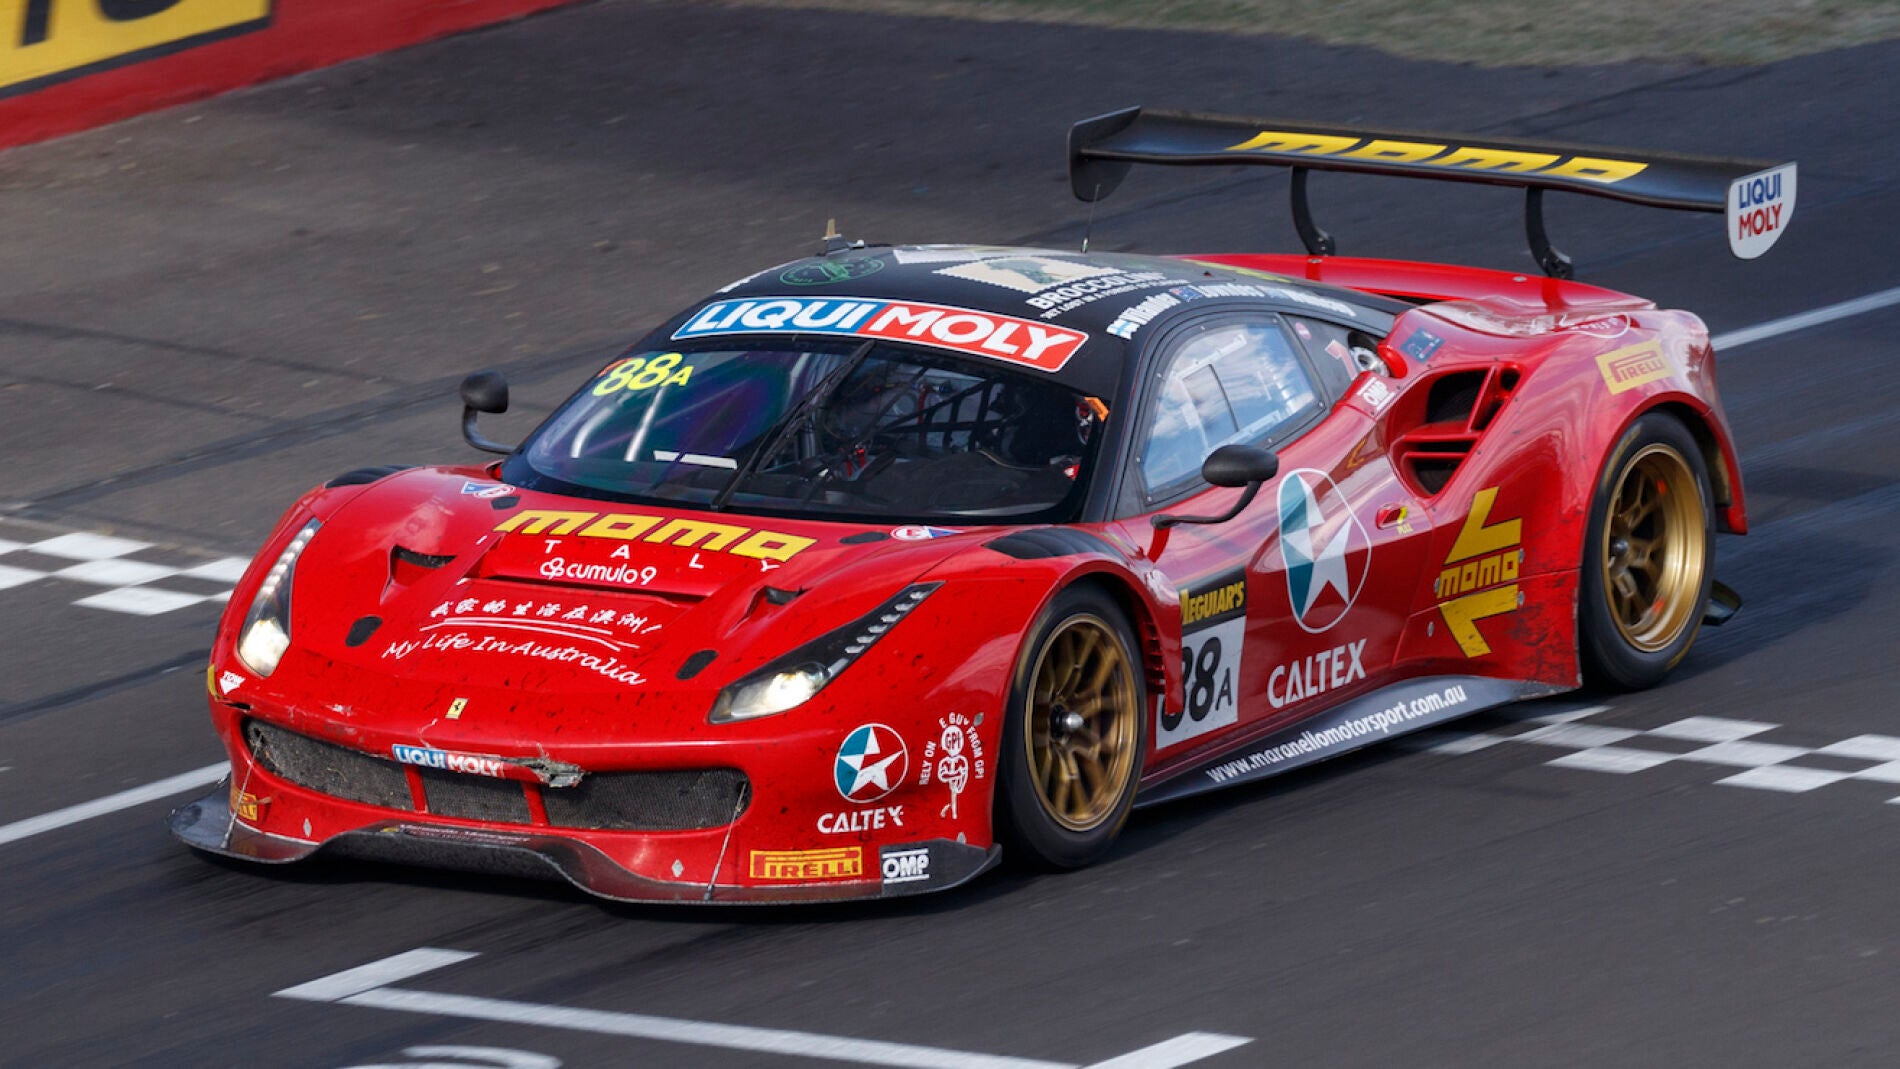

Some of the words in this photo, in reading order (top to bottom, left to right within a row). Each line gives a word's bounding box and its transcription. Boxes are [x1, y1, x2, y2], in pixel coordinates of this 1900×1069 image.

[1739, 173, 1782, 209] LIQUI
[1738, 203, 1783, 240] MOLY
[693, 300, 879, 329] LIQUI
[868, 306, 1079, 361] MOLY
[592, 353, 695, 396] 88A
[1608, 351, 1665, 384] PIRELLI
[1363, 380, 1390, 407] OMP
[382, 640, 421, 660] My
[422, 632, 475, 651] Life
[473, 635, 514, 652] In
[511, 640, 647, 686] Australia
[1267, 638, 1367, 709] CALTEX
[924, 740, 937, 758] ON
[966, 726, 984, 759] FROM
[1206, 685, 1468, 783] www.maranellomotorsport.com.au
[395, 747, 447, 769] LIQUI
[447, 754, 503, 777] MOLY
[753, 851, 859, 877] PIRELLI
[882, 854, 930, 878] OMP
